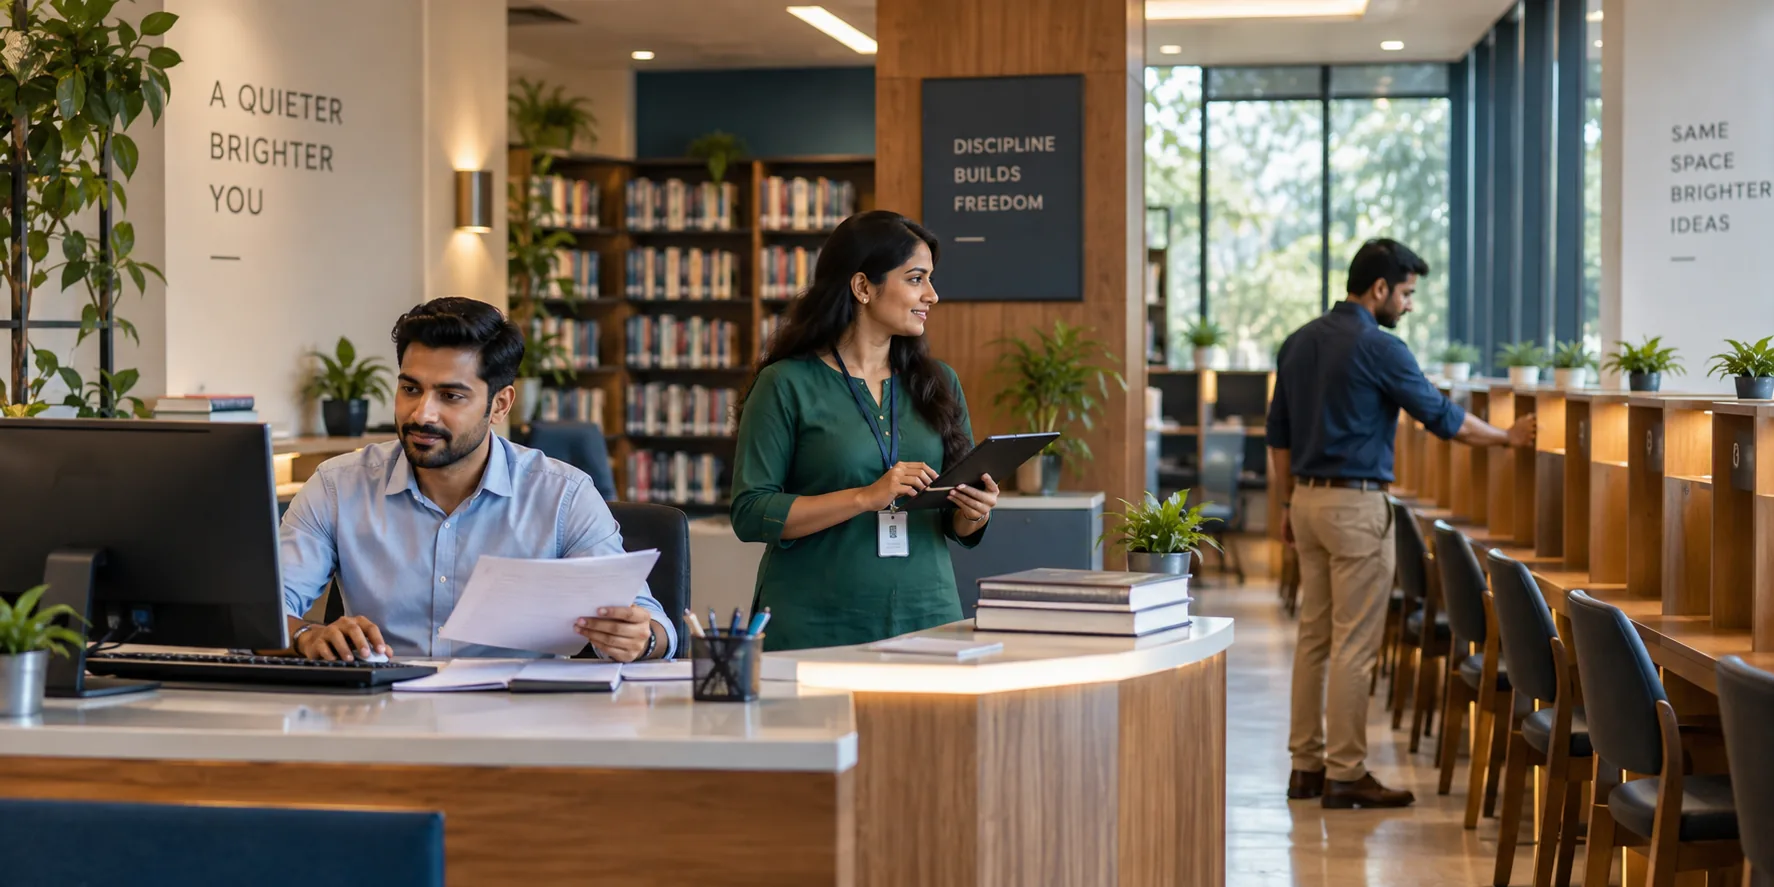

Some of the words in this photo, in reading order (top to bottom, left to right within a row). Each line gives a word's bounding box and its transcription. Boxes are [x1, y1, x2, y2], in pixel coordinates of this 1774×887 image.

[209, 80, 226, 108] A
[239, 84, 343, 124] QUIETER
[1671, 121, 1729, 143] SAME
[210, 132, 334, 172] BRIGHTER
[953, 135, 1056, 155] DISCIPLINE
[1671, 152, 1735, 173] SPACE
[954, 165, 1022, 184] BUILDS
[209, 184, 264, 216] YOU
[954, 194, 1044, 212] FREEDOM
[1671, 181, 1772, 204] BRIGHTER
[1671, 214, 1731, 234] IDEAS
